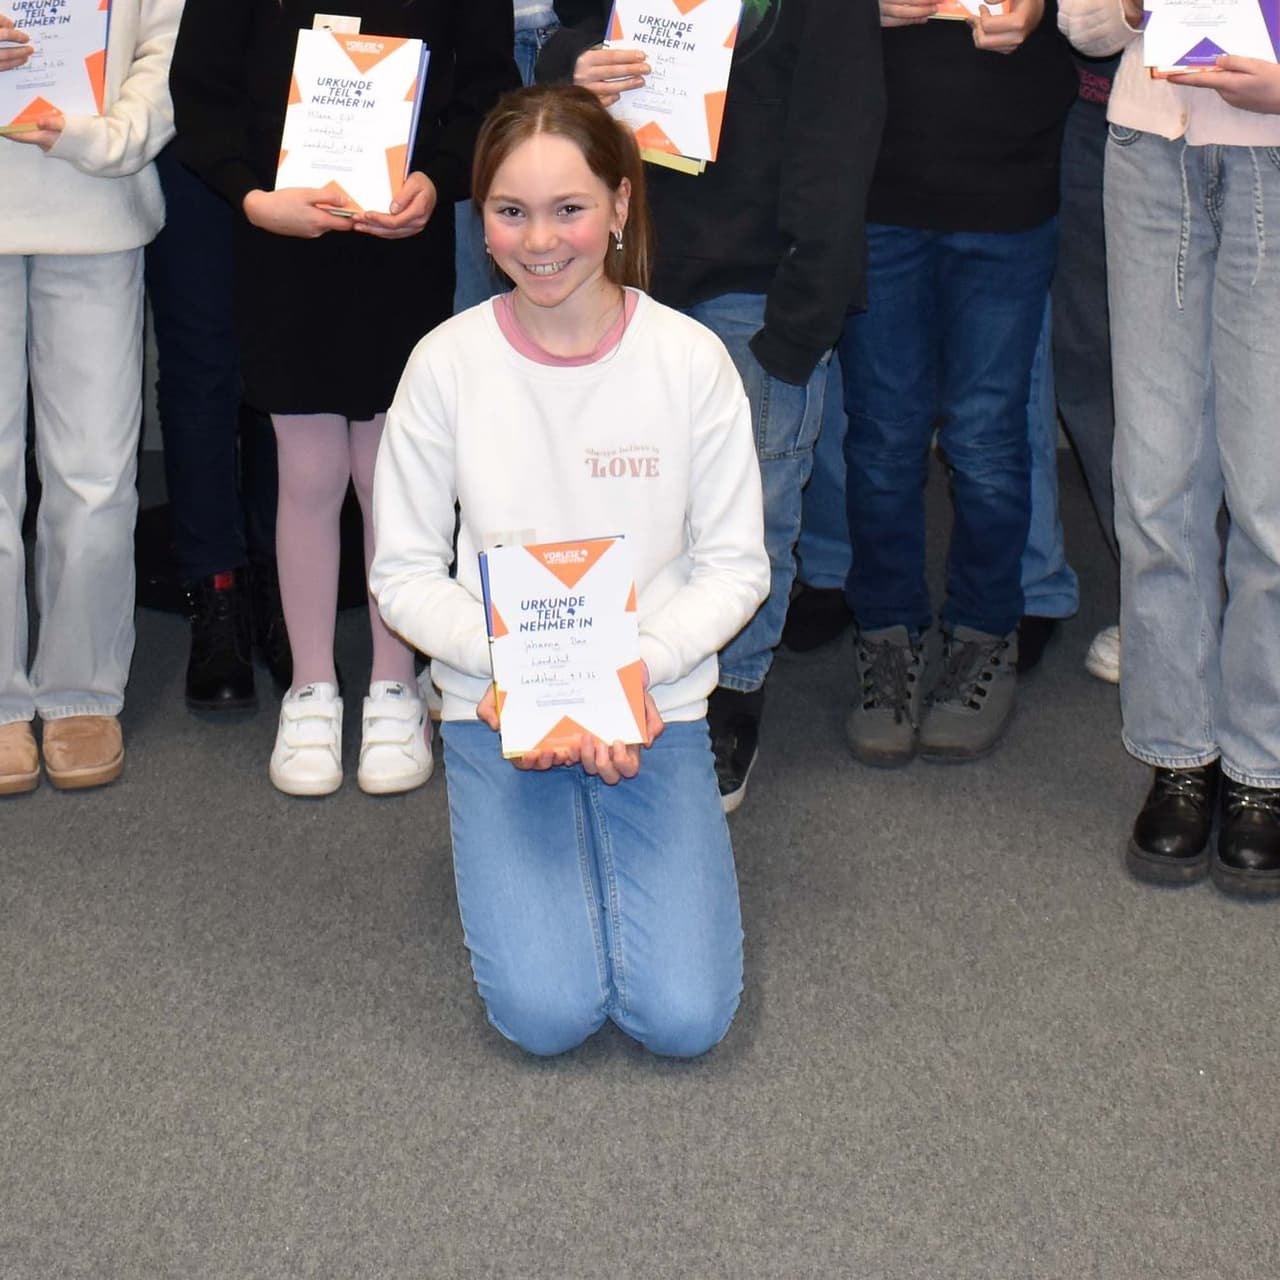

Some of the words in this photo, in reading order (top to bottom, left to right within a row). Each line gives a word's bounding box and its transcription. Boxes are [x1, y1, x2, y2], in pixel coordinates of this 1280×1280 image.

[25, 8, 46, 19] TEIL
[638, 14, 694, 33] URKUNDE
[650, 26, 671, 38] TEIL
[317, 76, 374, 90] URKUNDE
[329, 87, 350, 98] TEIL
[584, 457, 660, 478] LOVE
[521, 596, 585, 610] URKUNDE
[537, 609, 562, 620] TEIL
